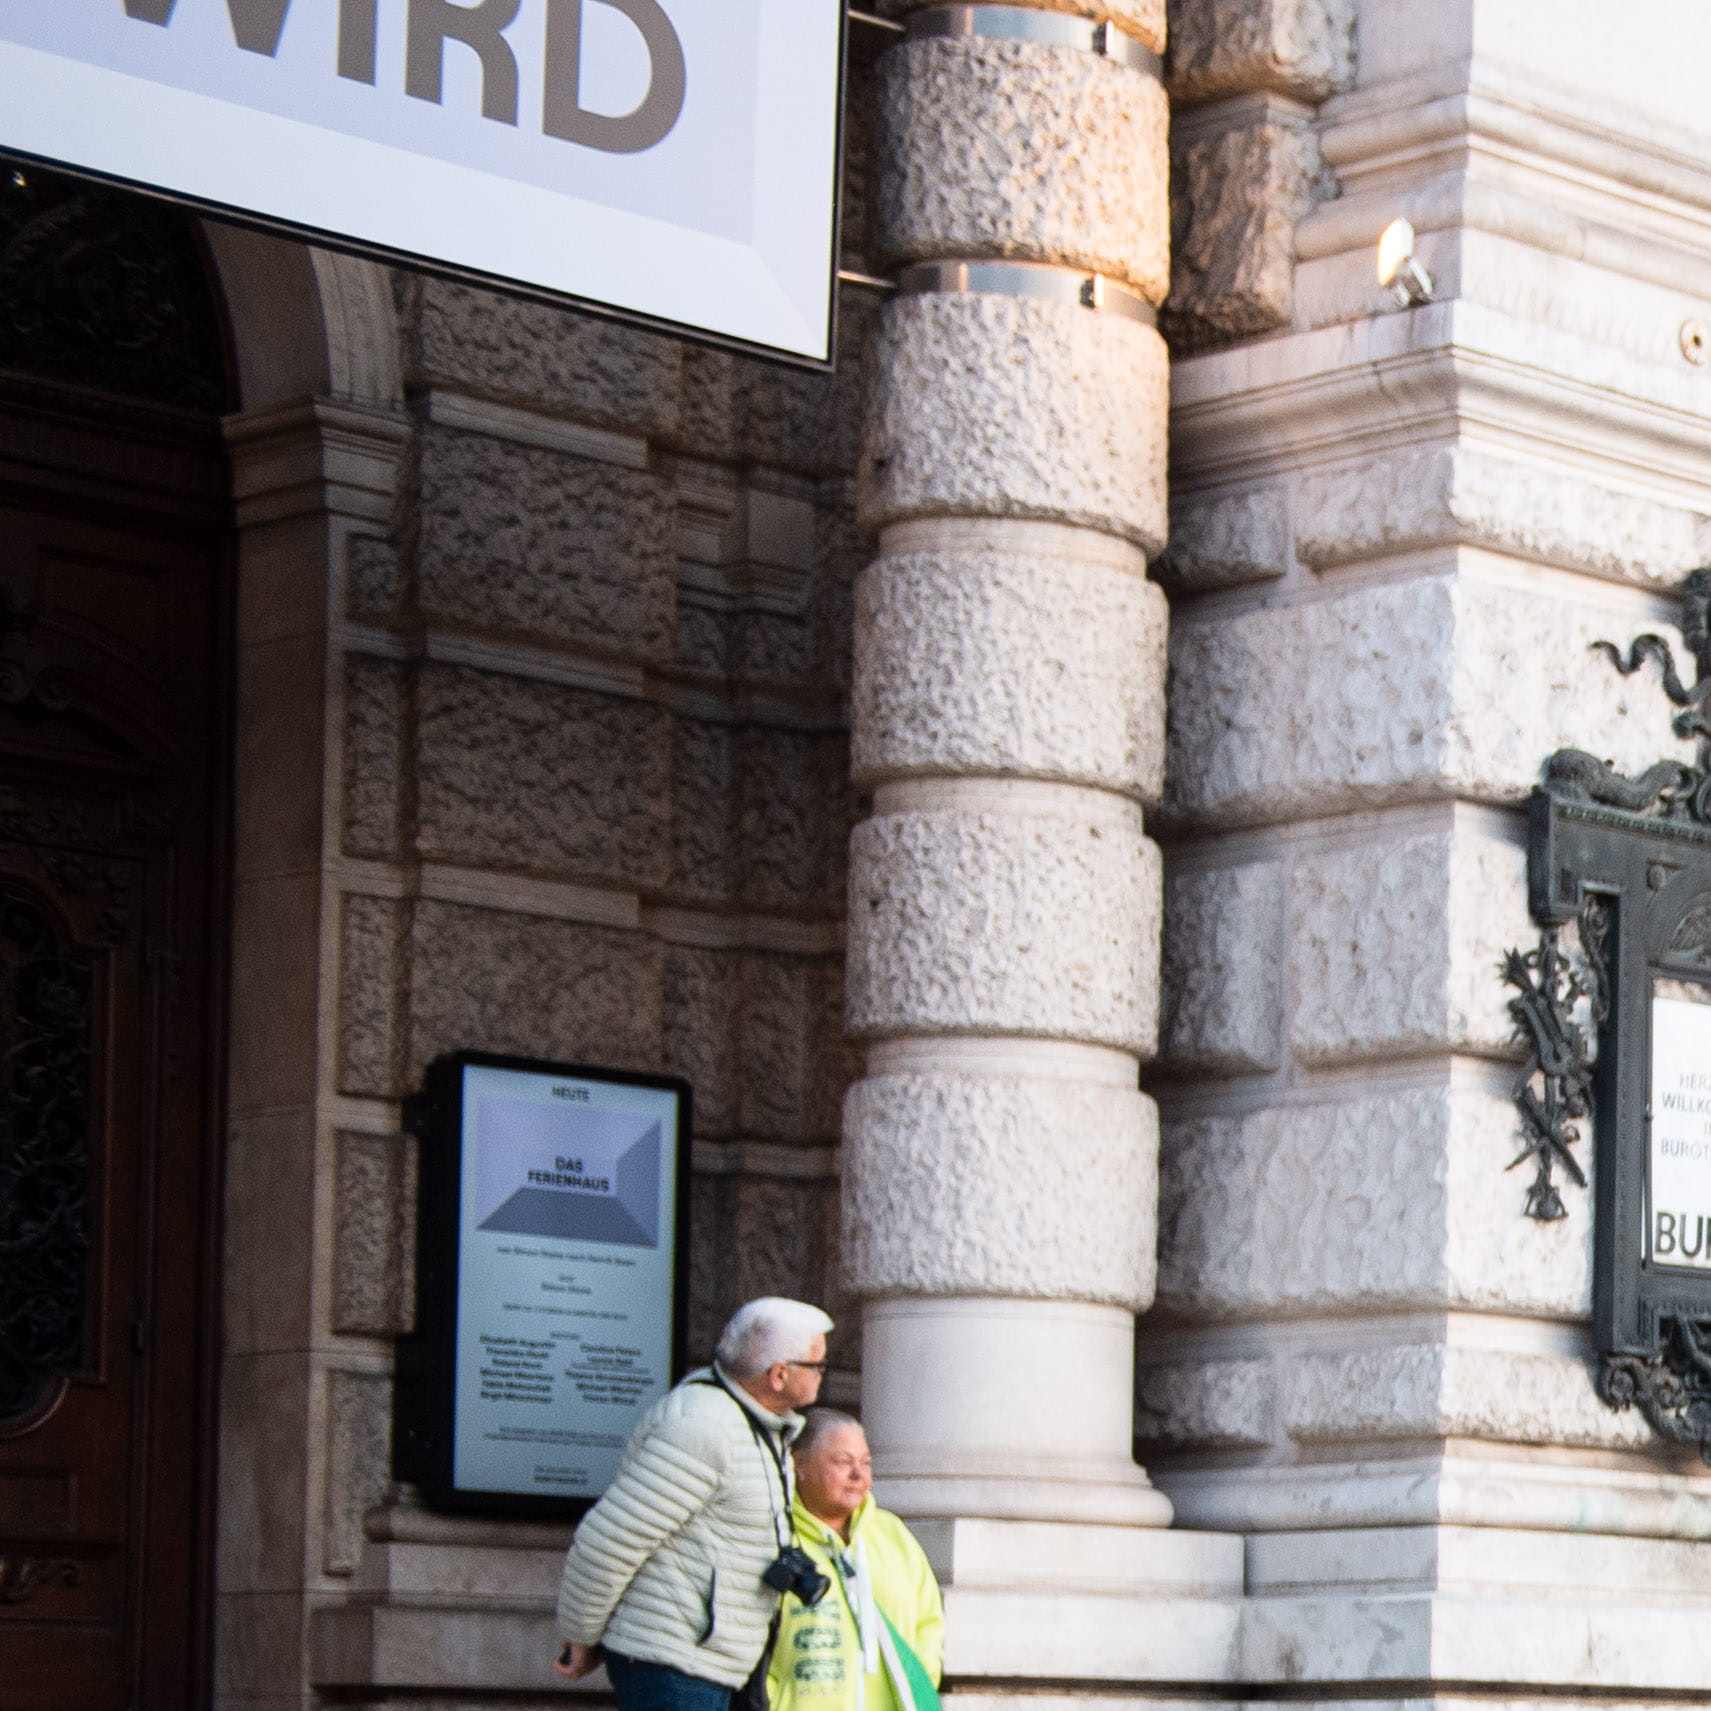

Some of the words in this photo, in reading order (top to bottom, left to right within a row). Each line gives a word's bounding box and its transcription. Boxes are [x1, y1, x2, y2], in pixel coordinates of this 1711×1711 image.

[552, 1086, 590, 1102] HEUTE
[555, 1156, 583, 1171] DAS
[527, 1169, 610, 1192] FERIENHAUS
